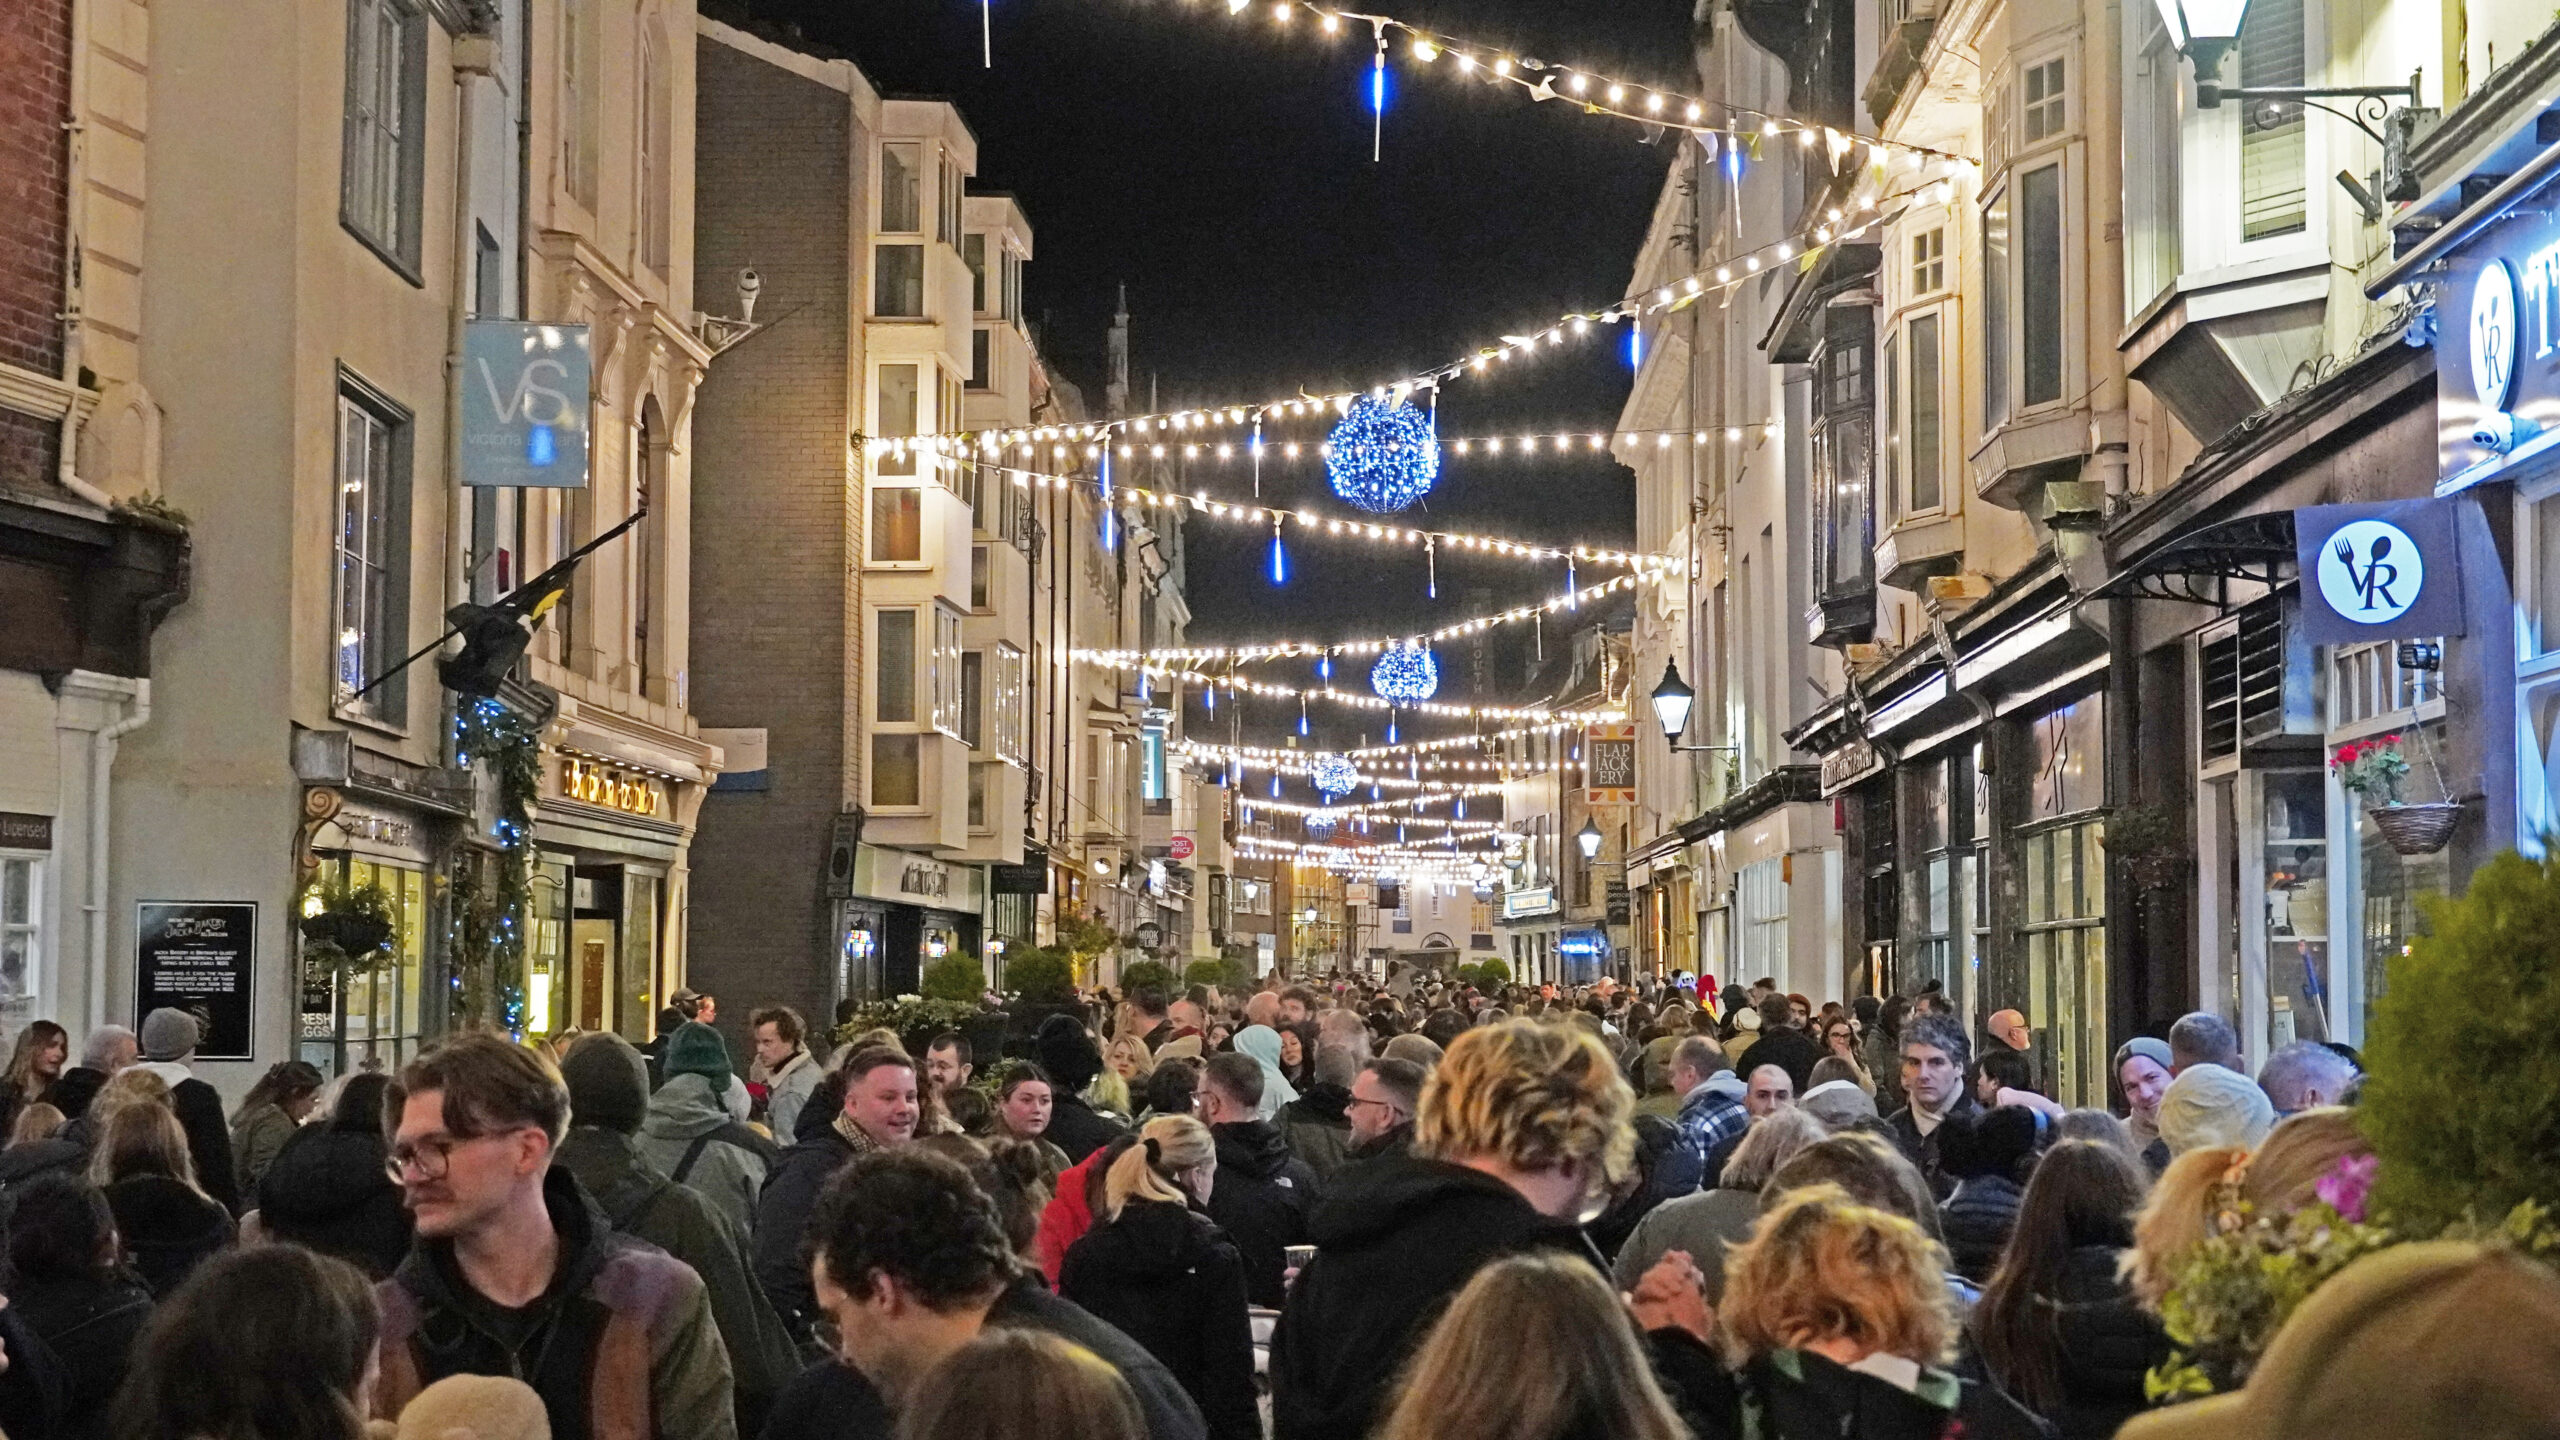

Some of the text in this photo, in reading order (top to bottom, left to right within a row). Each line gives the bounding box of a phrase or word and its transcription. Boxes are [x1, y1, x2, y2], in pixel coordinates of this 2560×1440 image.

[478, 357, 571, 425] VS
[467, 432, 522, 447] victoria
[2334, 536, 2404, 611] VR
[1595, 743, 1630, 757] FLAP
[1595, 756, 1630, 773] JACK
[1600, 770, 1626, 784] ERY
[1139, 930, 1159, 940] HOOK
[301, 1025, 332, 1038] GGS
